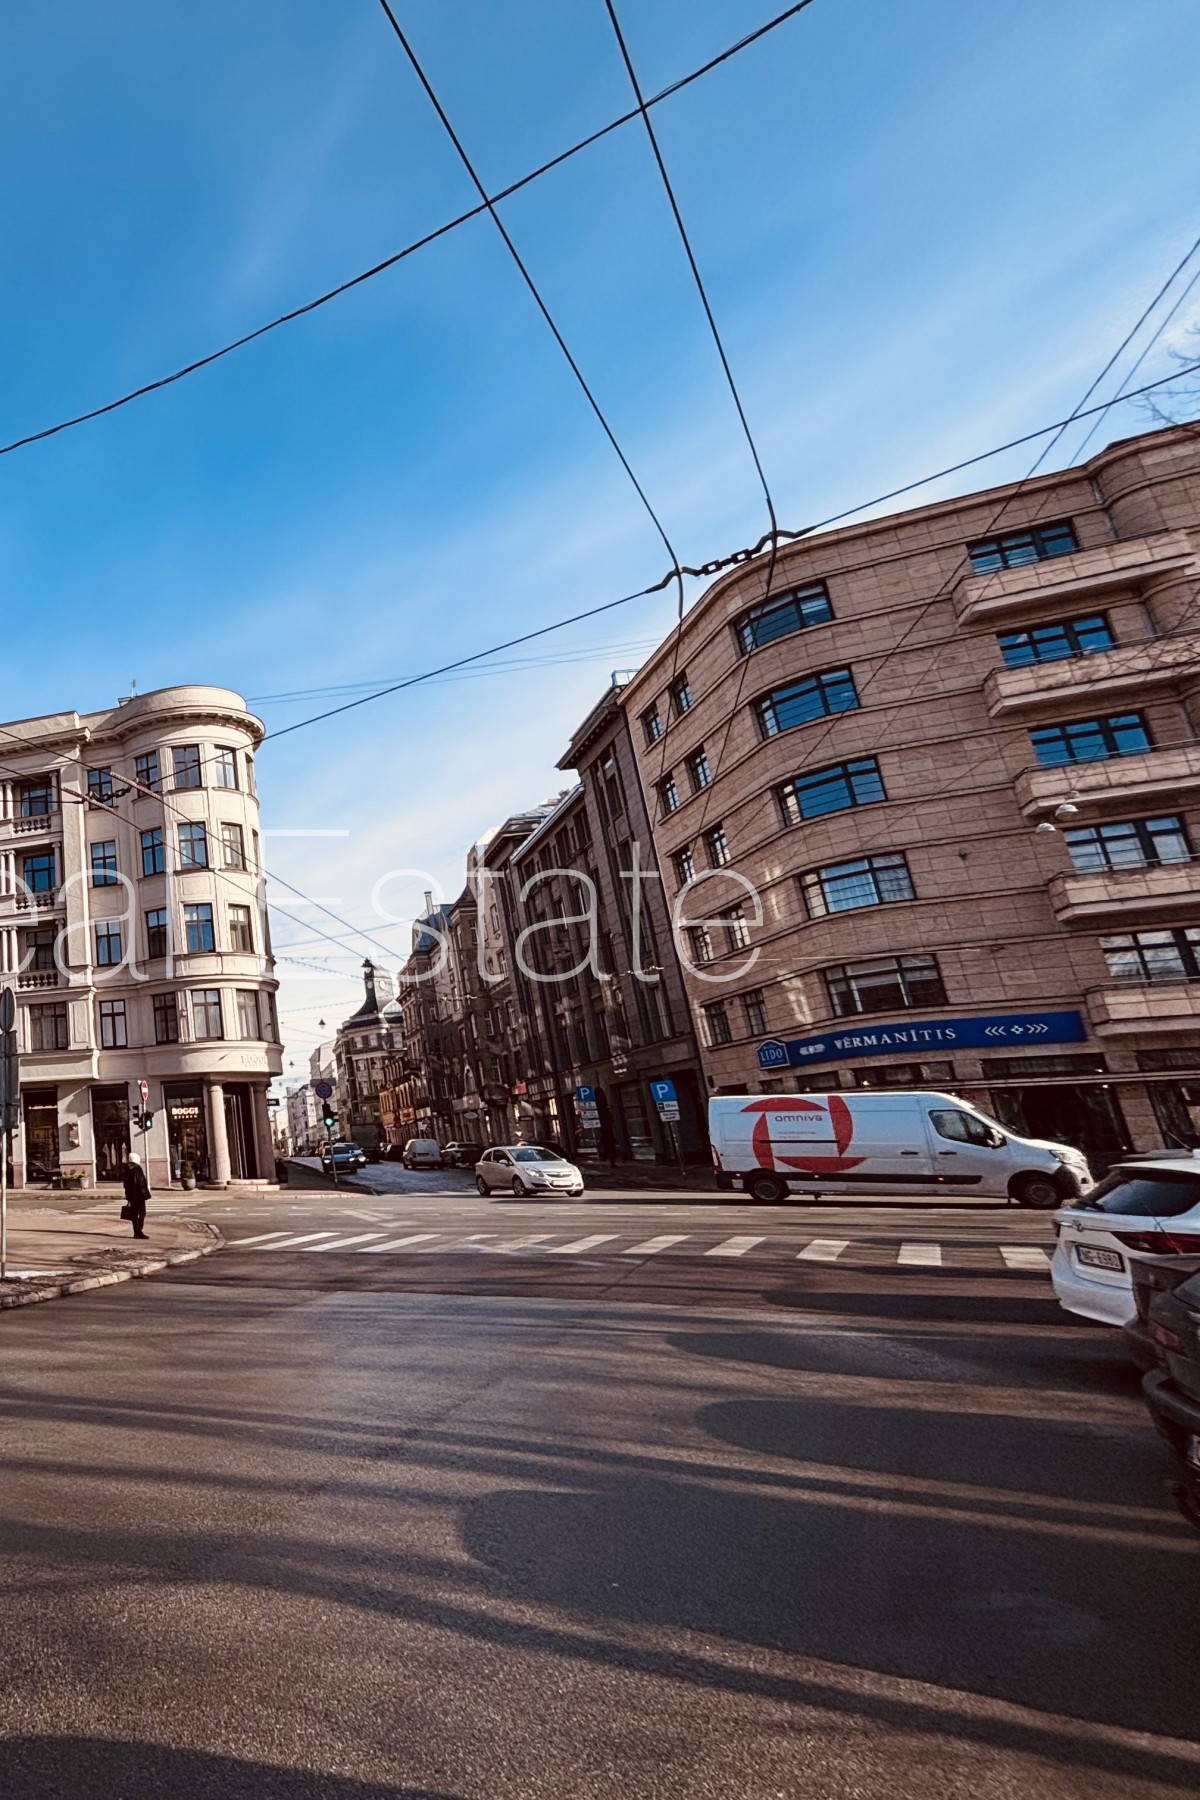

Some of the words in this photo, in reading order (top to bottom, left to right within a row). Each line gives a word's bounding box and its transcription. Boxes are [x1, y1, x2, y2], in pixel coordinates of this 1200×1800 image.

[834, 1028, 957, 1050] VĒRMANĪTIS
[760, 1048, 783, 1062] LIDO
[580, 1087, 590, 1100] P
[656, 1084, 669, 1099] P
[172, 1107, 199, 1115] BOGGI
[774, 1114, 824, 1122] omniva
